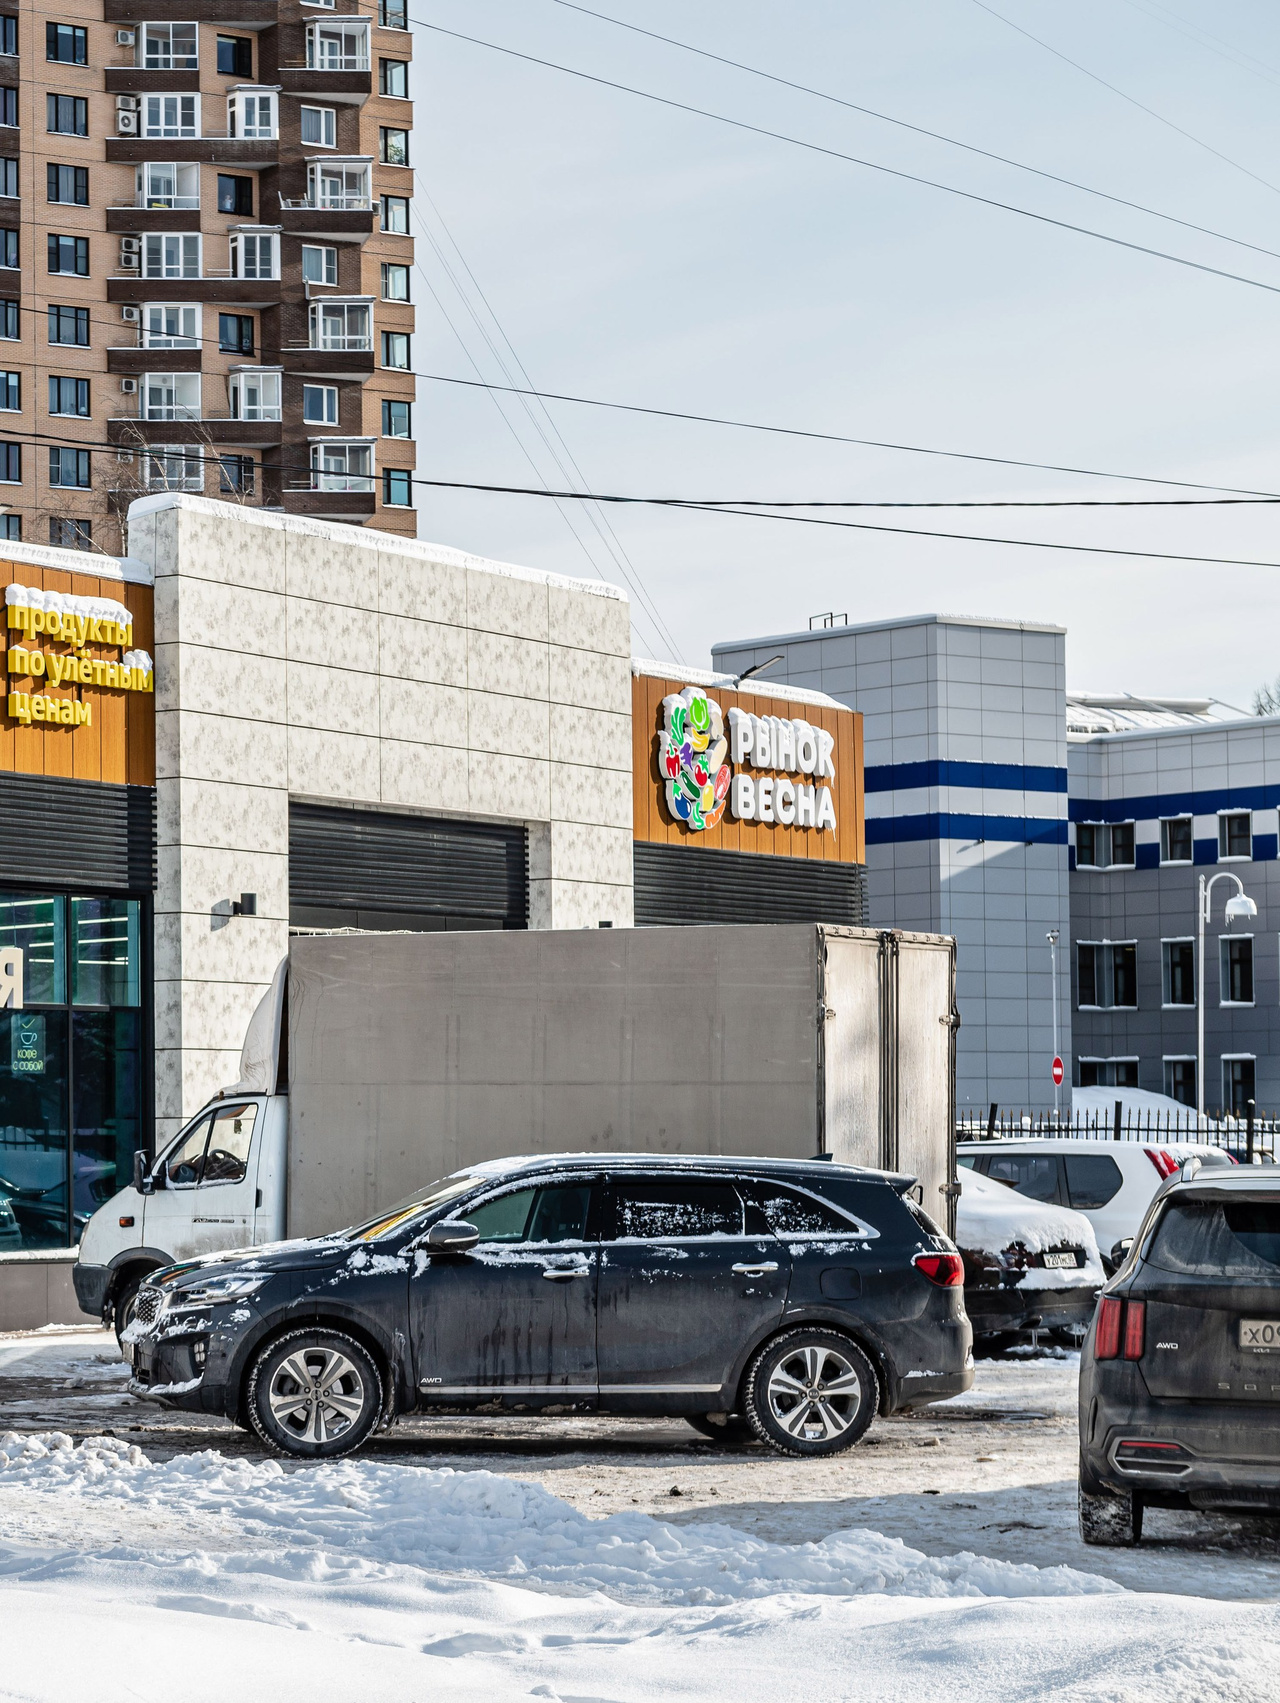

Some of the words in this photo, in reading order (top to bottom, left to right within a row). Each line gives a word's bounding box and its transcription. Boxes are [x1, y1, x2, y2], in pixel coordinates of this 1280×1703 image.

[8, 604, 133, 647] продукты
[8, 649, 46, 676] по
[45, 649, 154, 692] улётным
[8, 692, 92, 727] ценам
[729, 716, 836, 777] РЫНОК
[731, 773, 837, 829] ВЕСНА
